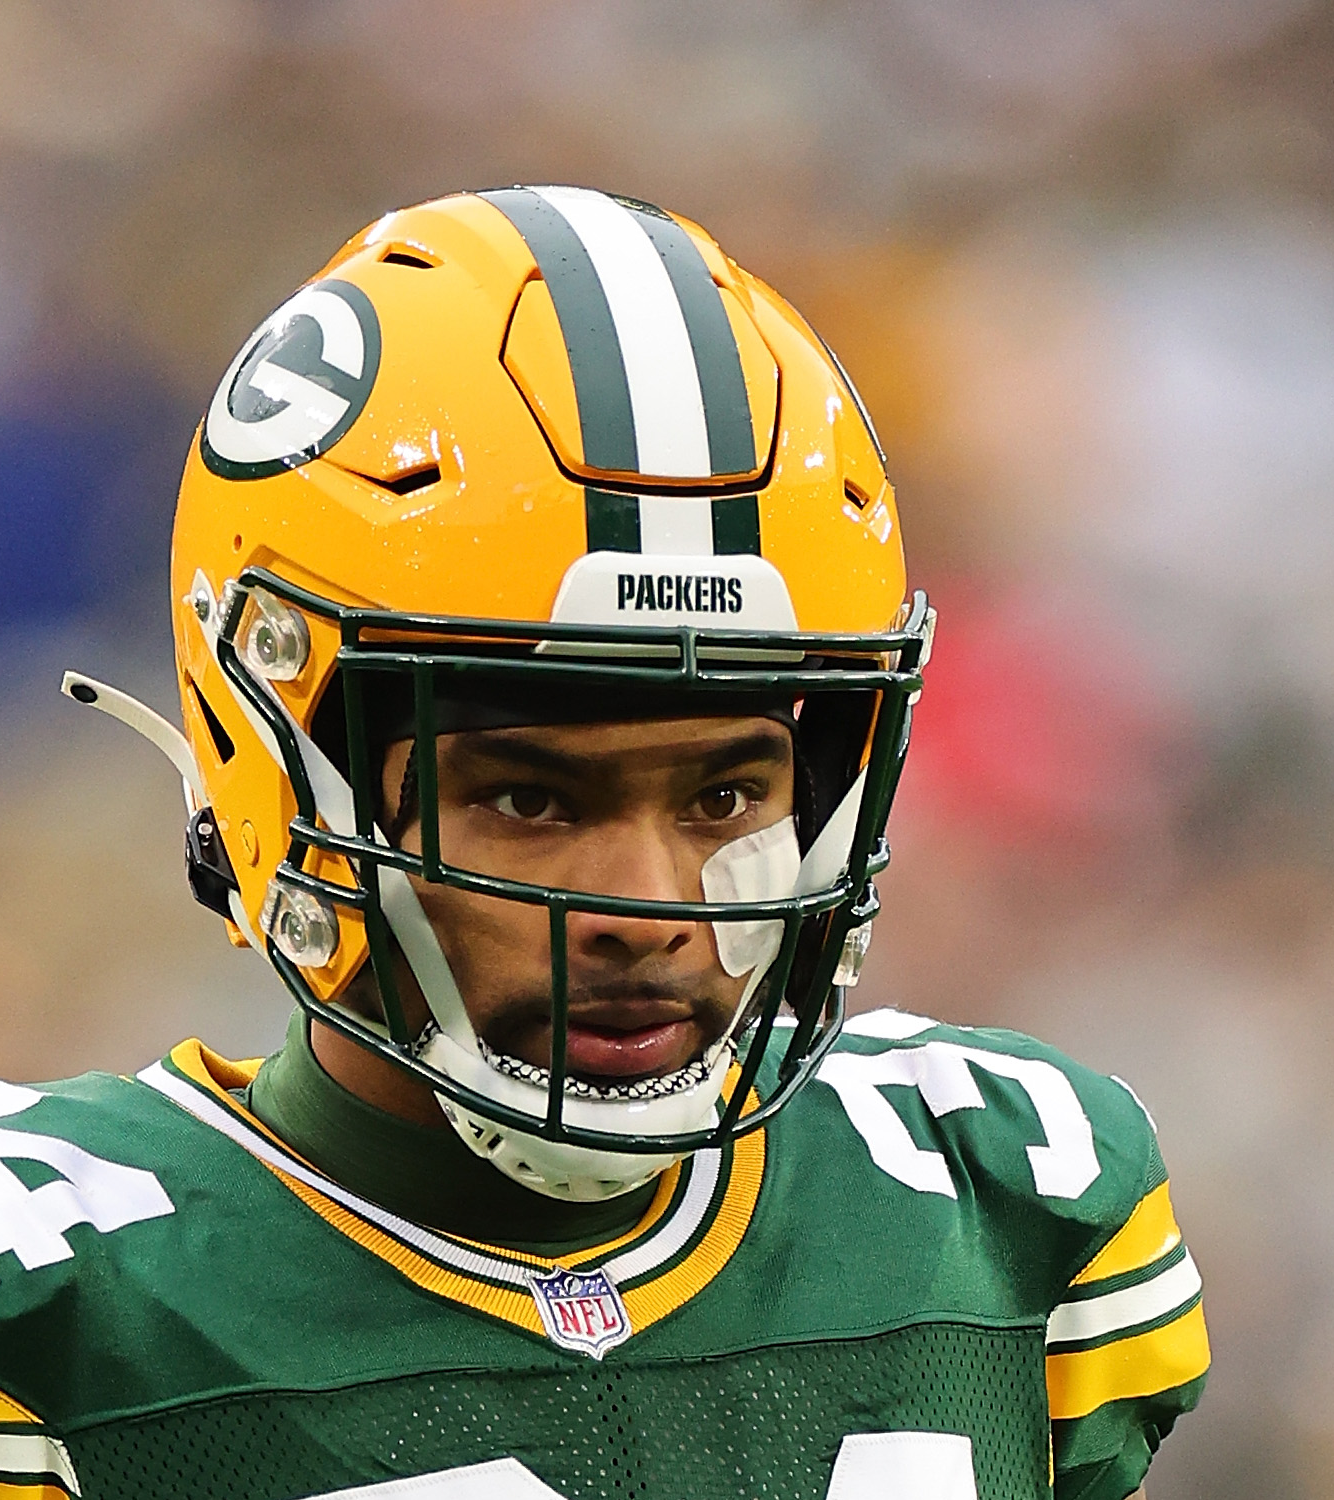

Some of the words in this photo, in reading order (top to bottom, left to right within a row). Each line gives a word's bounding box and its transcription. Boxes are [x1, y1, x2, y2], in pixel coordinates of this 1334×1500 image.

[206, 288, 365, 464] G
[617, 573, 743, 614] PACKERS
[554, 1297, 617, 1338] NFL
